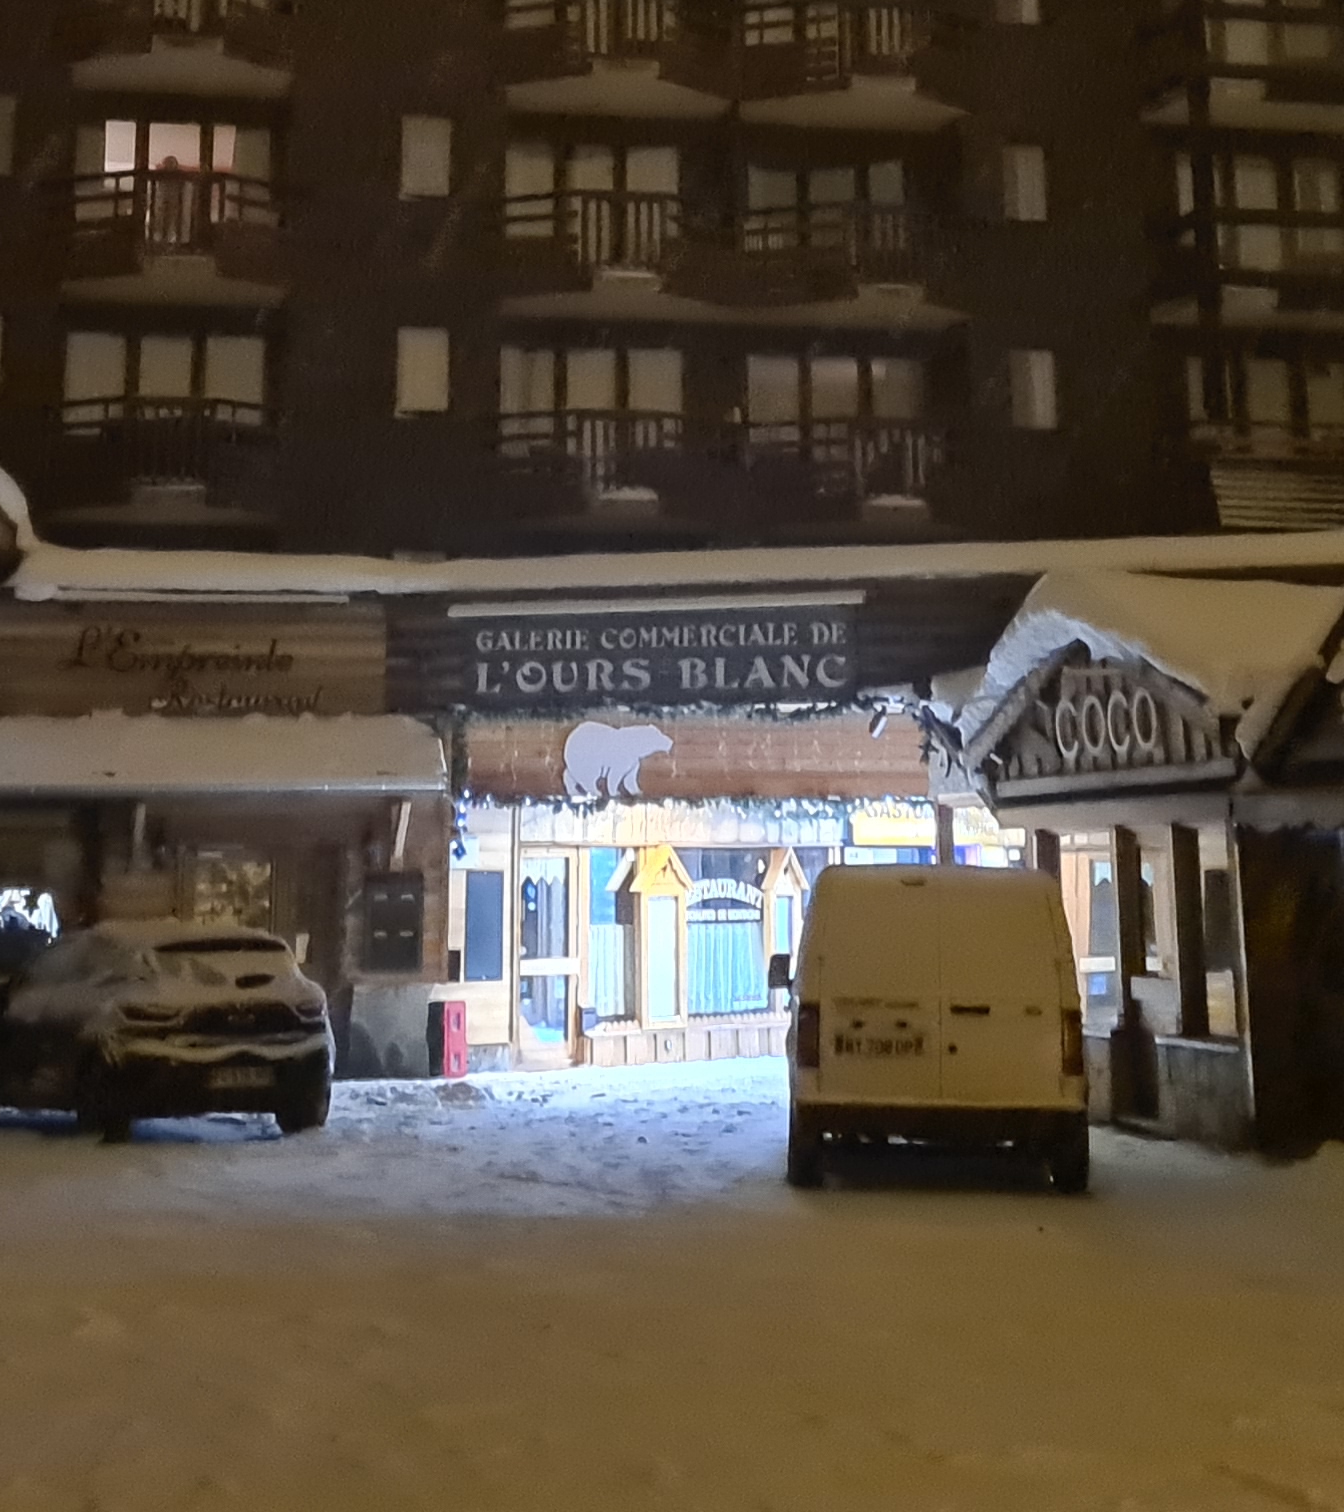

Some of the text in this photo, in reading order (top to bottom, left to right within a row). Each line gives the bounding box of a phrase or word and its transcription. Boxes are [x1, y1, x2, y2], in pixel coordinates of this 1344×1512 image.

[476, 621, 847, 653] GALERIE COMMERCIALE DE
[476, 654, 848, 693] L'OURS BLANC
[1056, 686, 1156, 759] COCO
